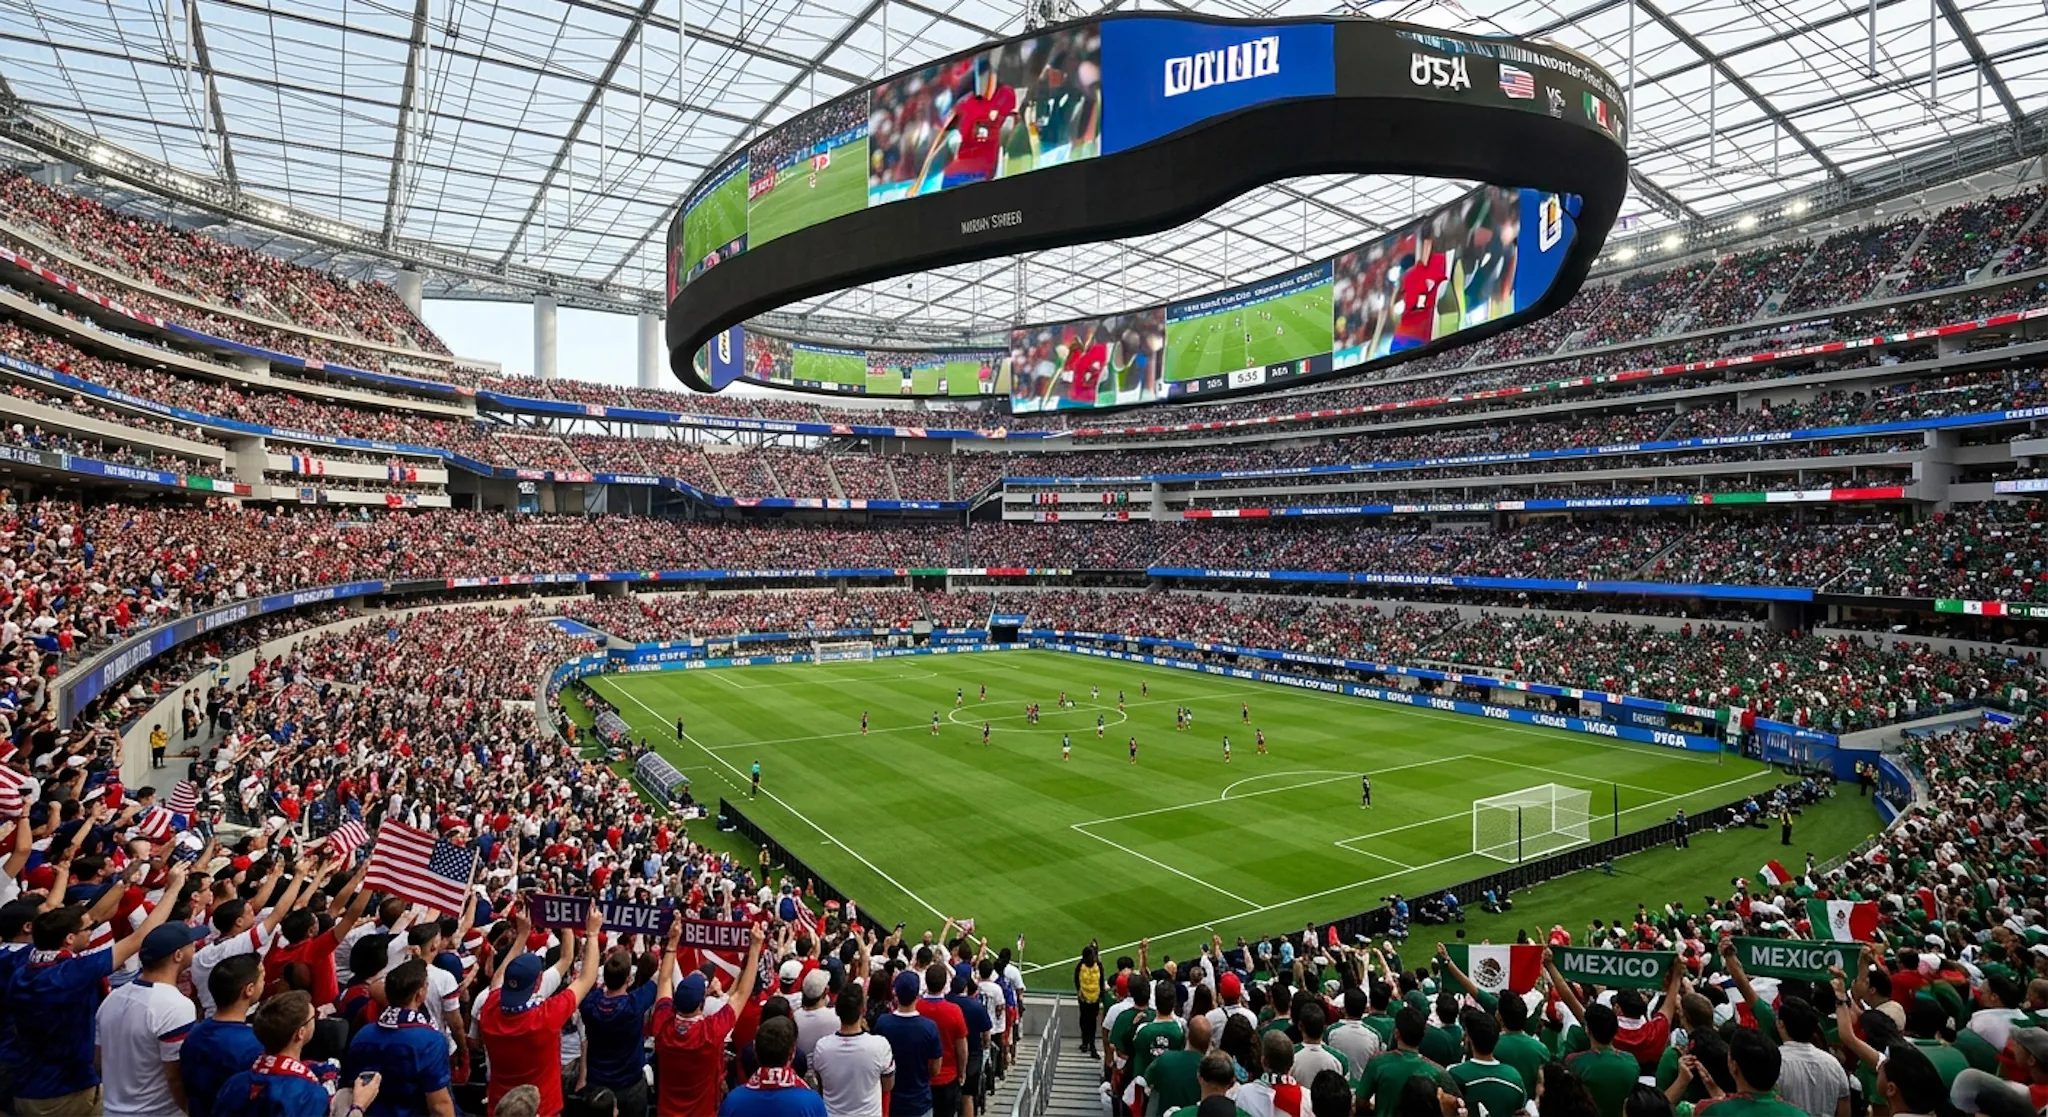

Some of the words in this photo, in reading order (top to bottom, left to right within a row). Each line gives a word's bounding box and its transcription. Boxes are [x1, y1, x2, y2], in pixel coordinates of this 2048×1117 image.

[1410, 52, 1472, 91] USA
[685, 923, 750, 947] BELIEVE
[1564, 952, 1660, 978] MEXICO
[1751, 945, 1844, 970] MEXICO
